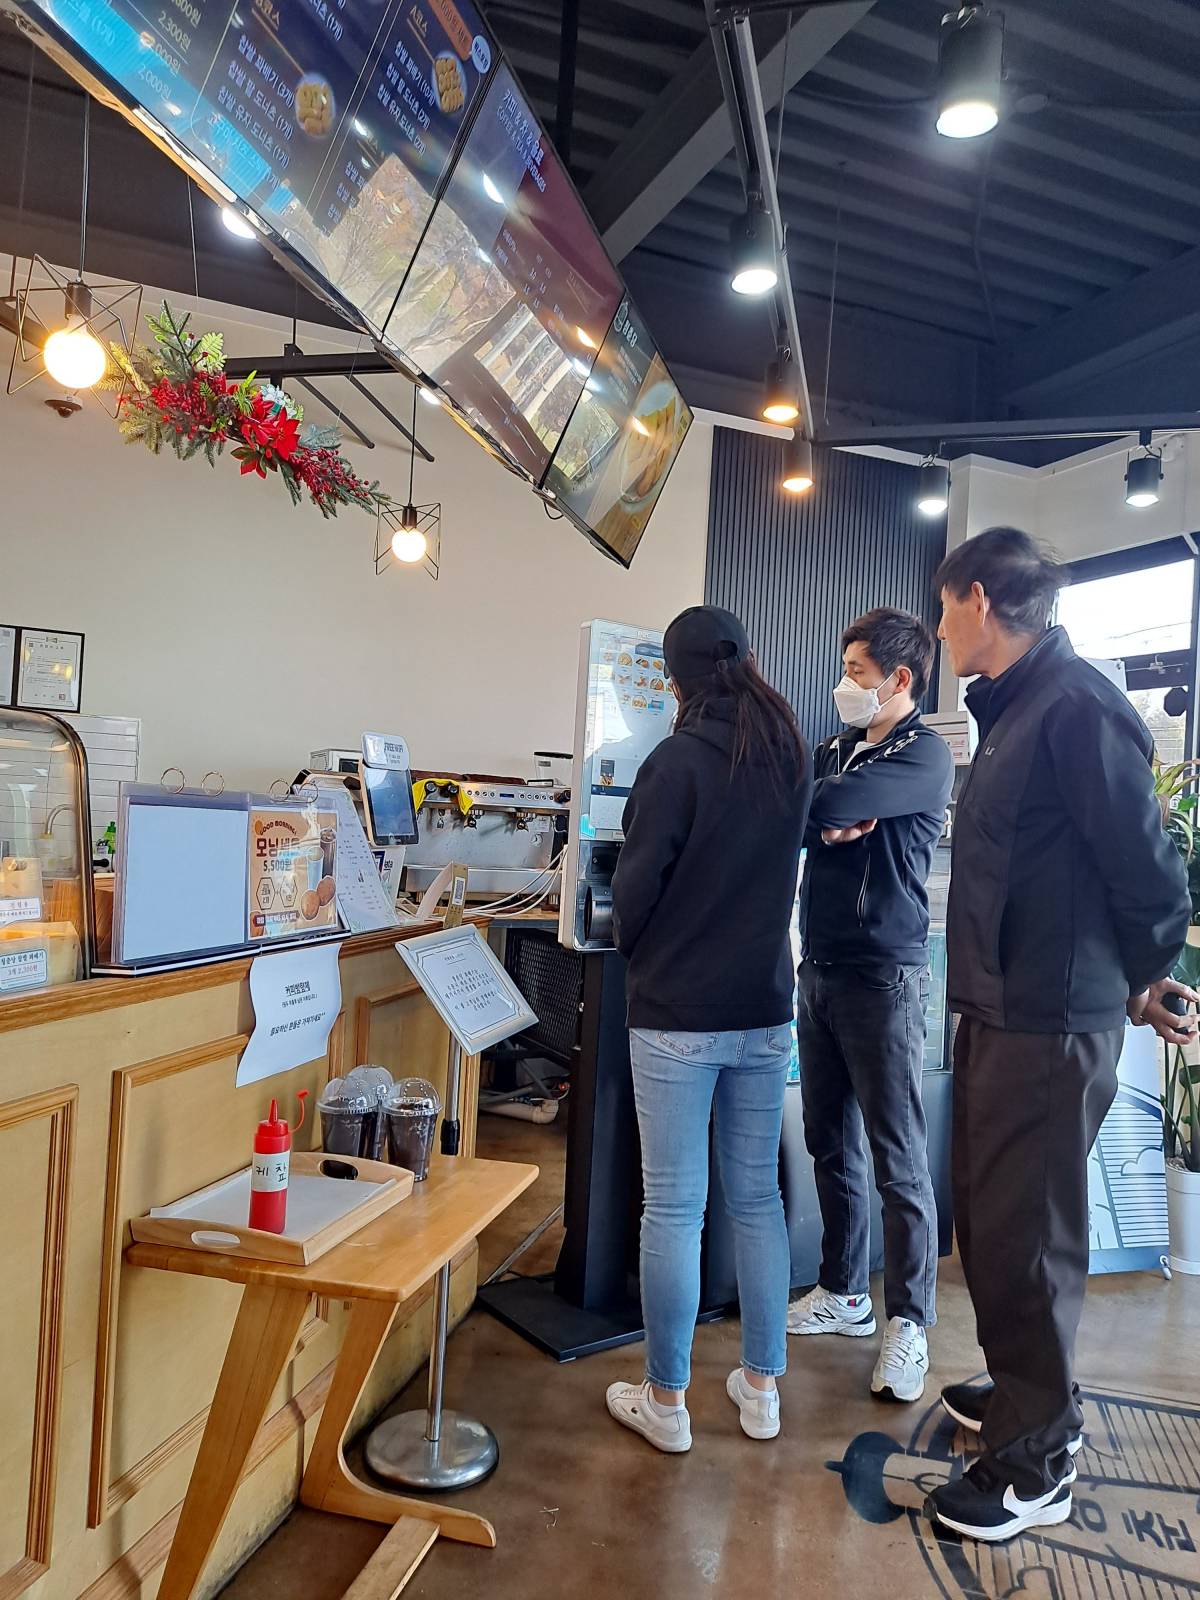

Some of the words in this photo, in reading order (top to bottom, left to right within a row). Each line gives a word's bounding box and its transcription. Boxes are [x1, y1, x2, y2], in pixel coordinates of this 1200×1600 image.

[238, 34, 257, 63] 찹쌀
[228, 60, 247, 88] 찹쌀
[217, 86, 237, 113] 찹쌀
[235, 104, 253, 129] 유자
